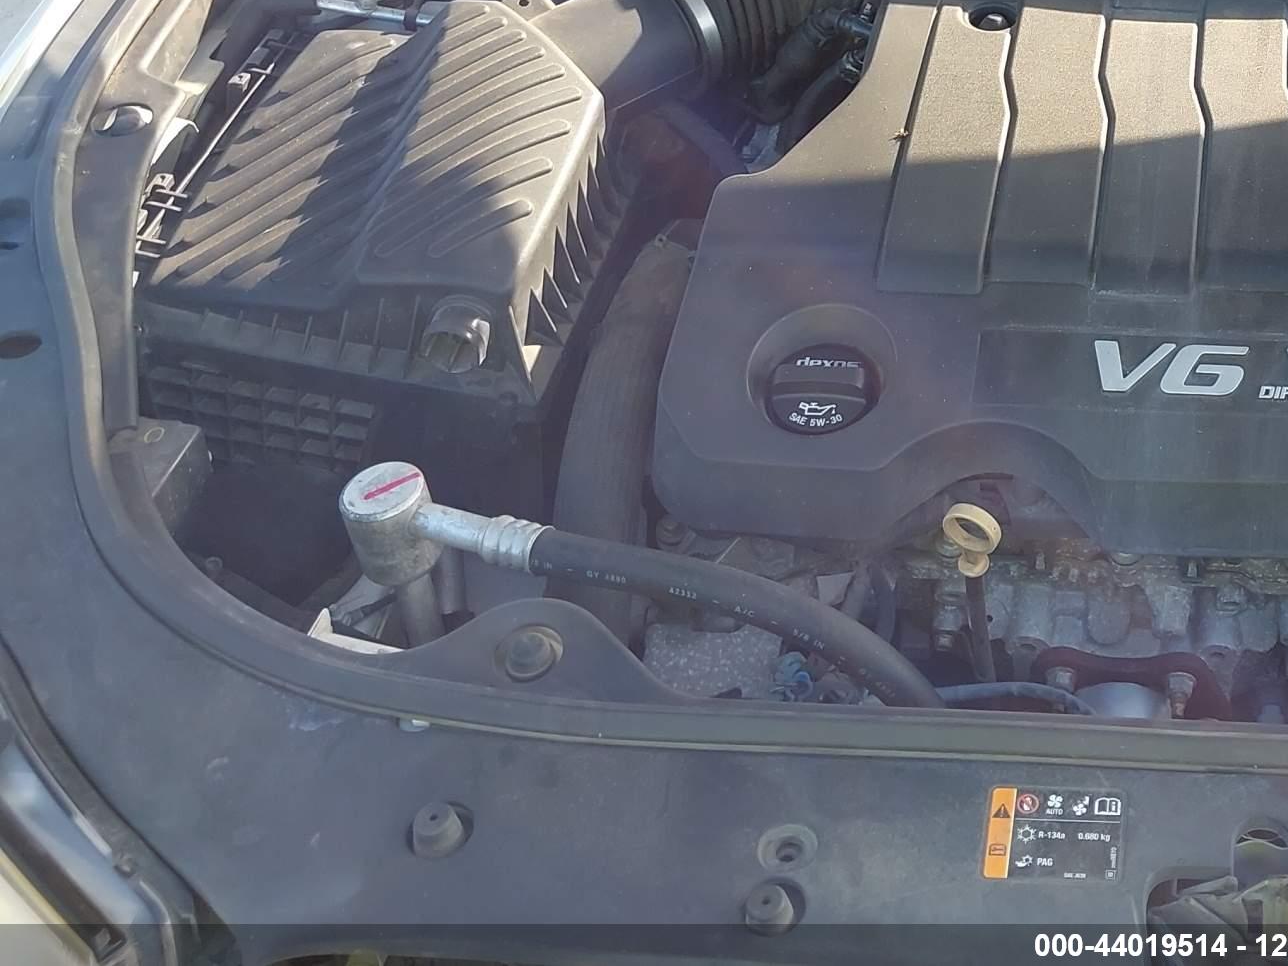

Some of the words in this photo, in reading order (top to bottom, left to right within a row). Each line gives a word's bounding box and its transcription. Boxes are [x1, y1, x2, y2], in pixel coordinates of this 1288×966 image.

[1094, 340, 1250, 396] V6
[789, 413, 808, 425] SAE
[810, 414, 843, 427] 5W-30
[734, 605, 756, 618] A/C
[1101, 833, 1111, 842] kg
[1037, 857, 1053, 867] PAG
